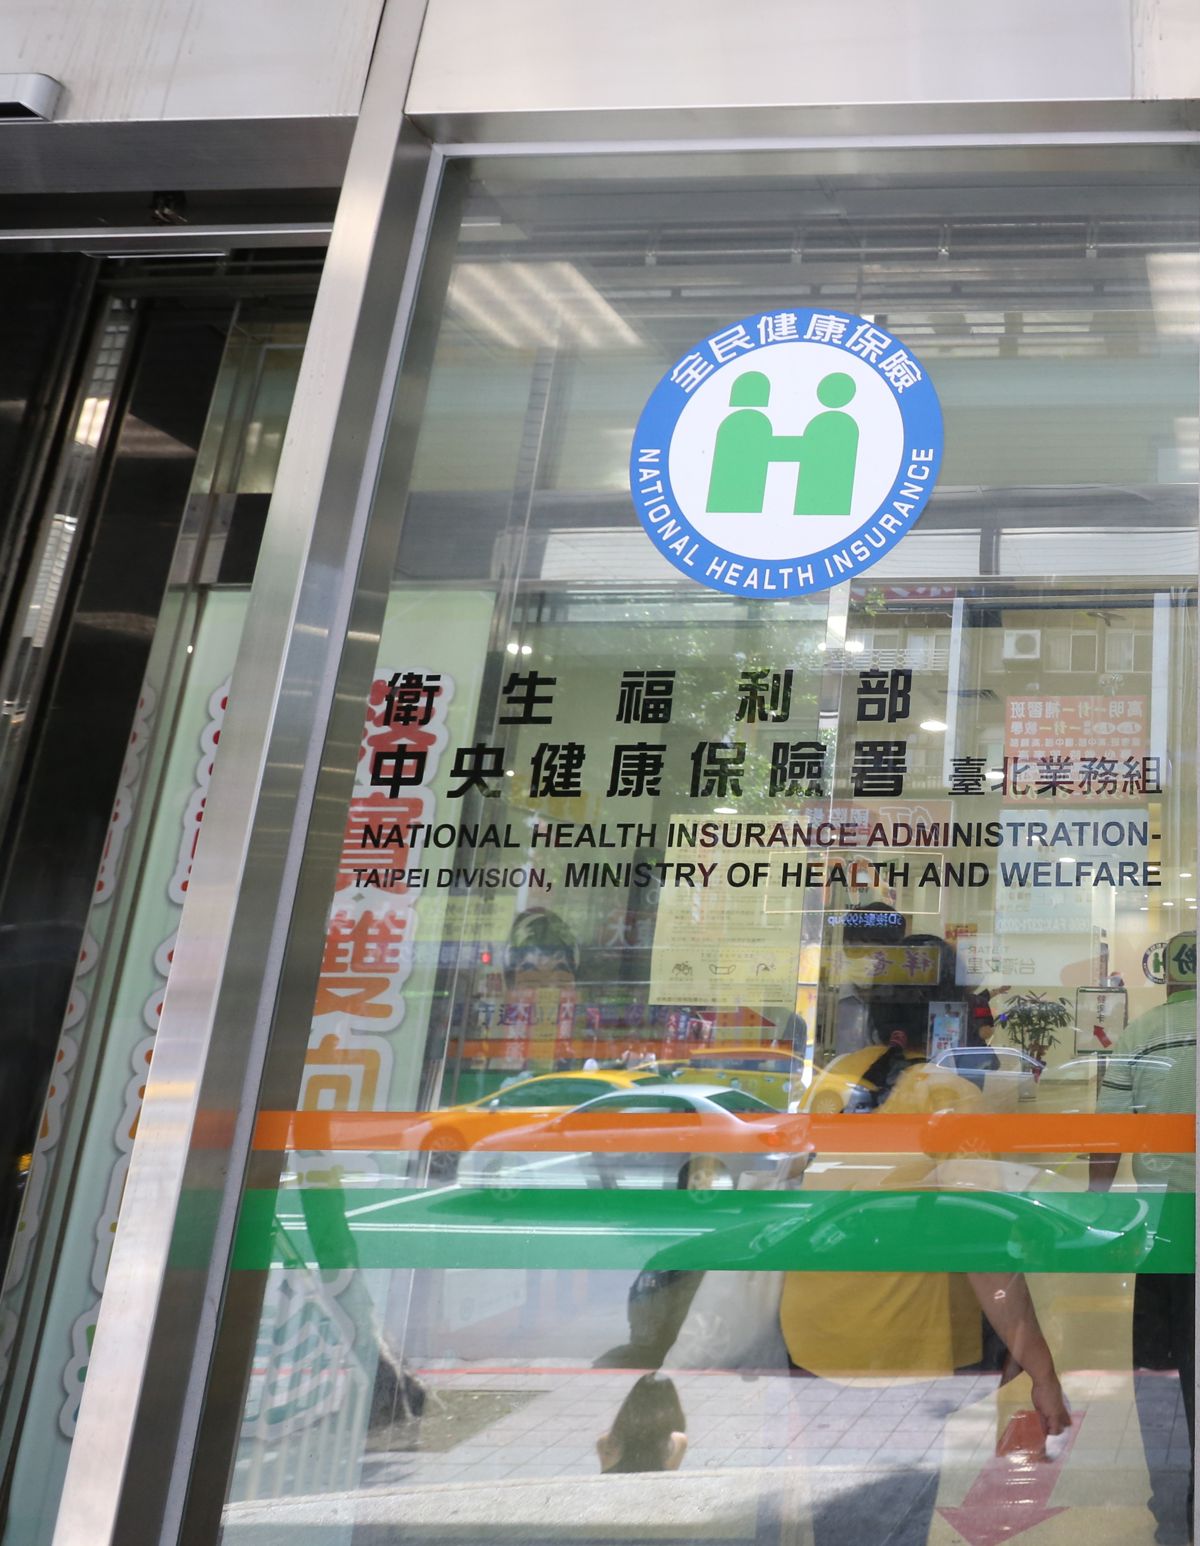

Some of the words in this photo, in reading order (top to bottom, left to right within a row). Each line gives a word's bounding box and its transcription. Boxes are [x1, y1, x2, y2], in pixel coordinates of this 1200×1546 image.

[670, 312, 922, 394] 全民健康保險
[638, 448, 699, 567] NATIONAL
[706, 555, 814, 590] HEALTH
[824, 448, 933, 578] INSURANCE
[384, 669, 911, 727] 衛生福利部
[370, 741, 908, 799] 中央健康保險署
[948, 755, 1162, 796] 臺北業務組
[360, 823, 520, 848] NATIONAL
[531, 823, 656, 848] HEALTH
[667, 823, 858, 848] INSURANCE
[867, 821, 1161, 848] ADMINISTRATION-
[353, 868, 429, 889] TAIPEI
[437, 868, 552, 892] DIVISION,
[564, 862, 718, 888] MINISTRY
[727, 862, 770, 888] OF
[781, 862, 909, 888] HEALTH
[918, 862, 990, 888] AND
[1001, 861, 1161, 888] WELFARE
